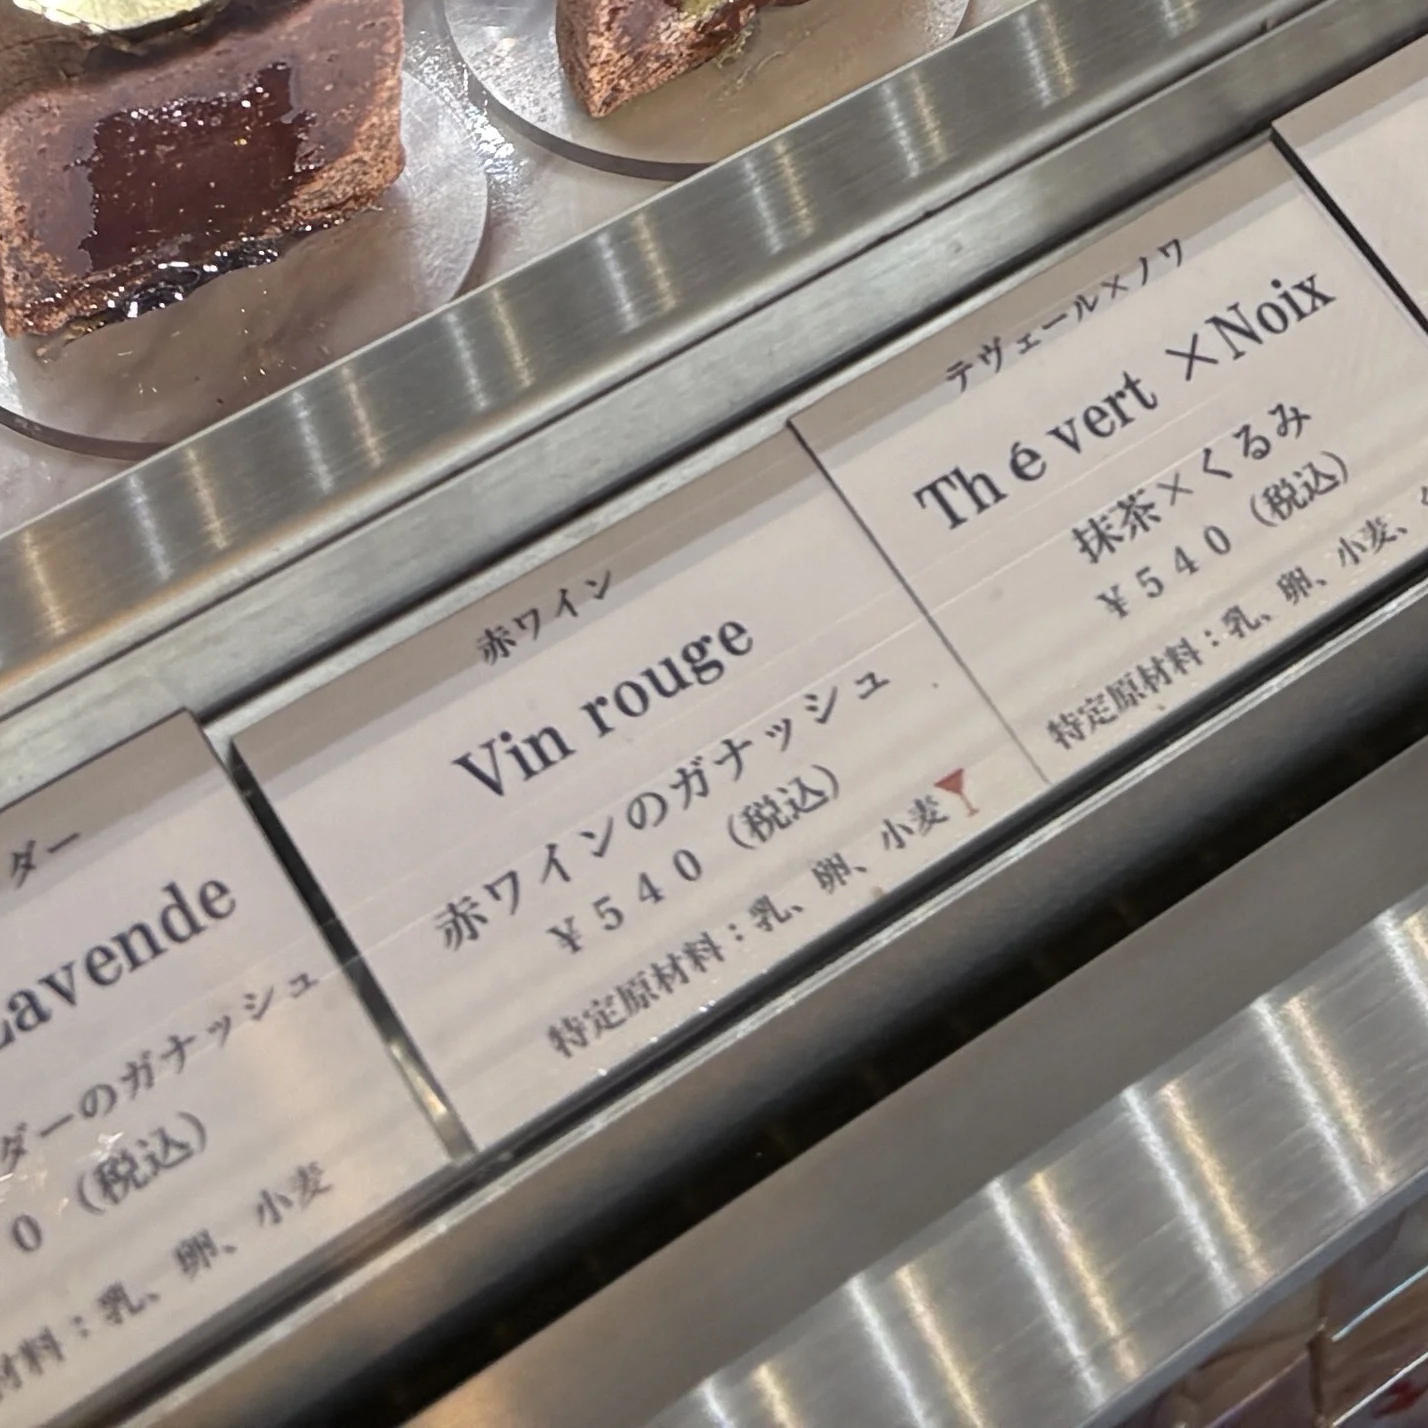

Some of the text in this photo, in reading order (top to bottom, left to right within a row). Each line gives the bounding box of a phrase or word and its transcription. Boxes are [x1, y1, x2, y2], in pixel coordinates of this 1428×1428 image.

[1072, 401, 1313, 565] 抹茶×くるみ
[477, 569, 613, 664] 赤ワイン
[451, 619, 755, 802] Vin rouge
[433, 671, 891, 950] 赤ワインのガナッシュ
